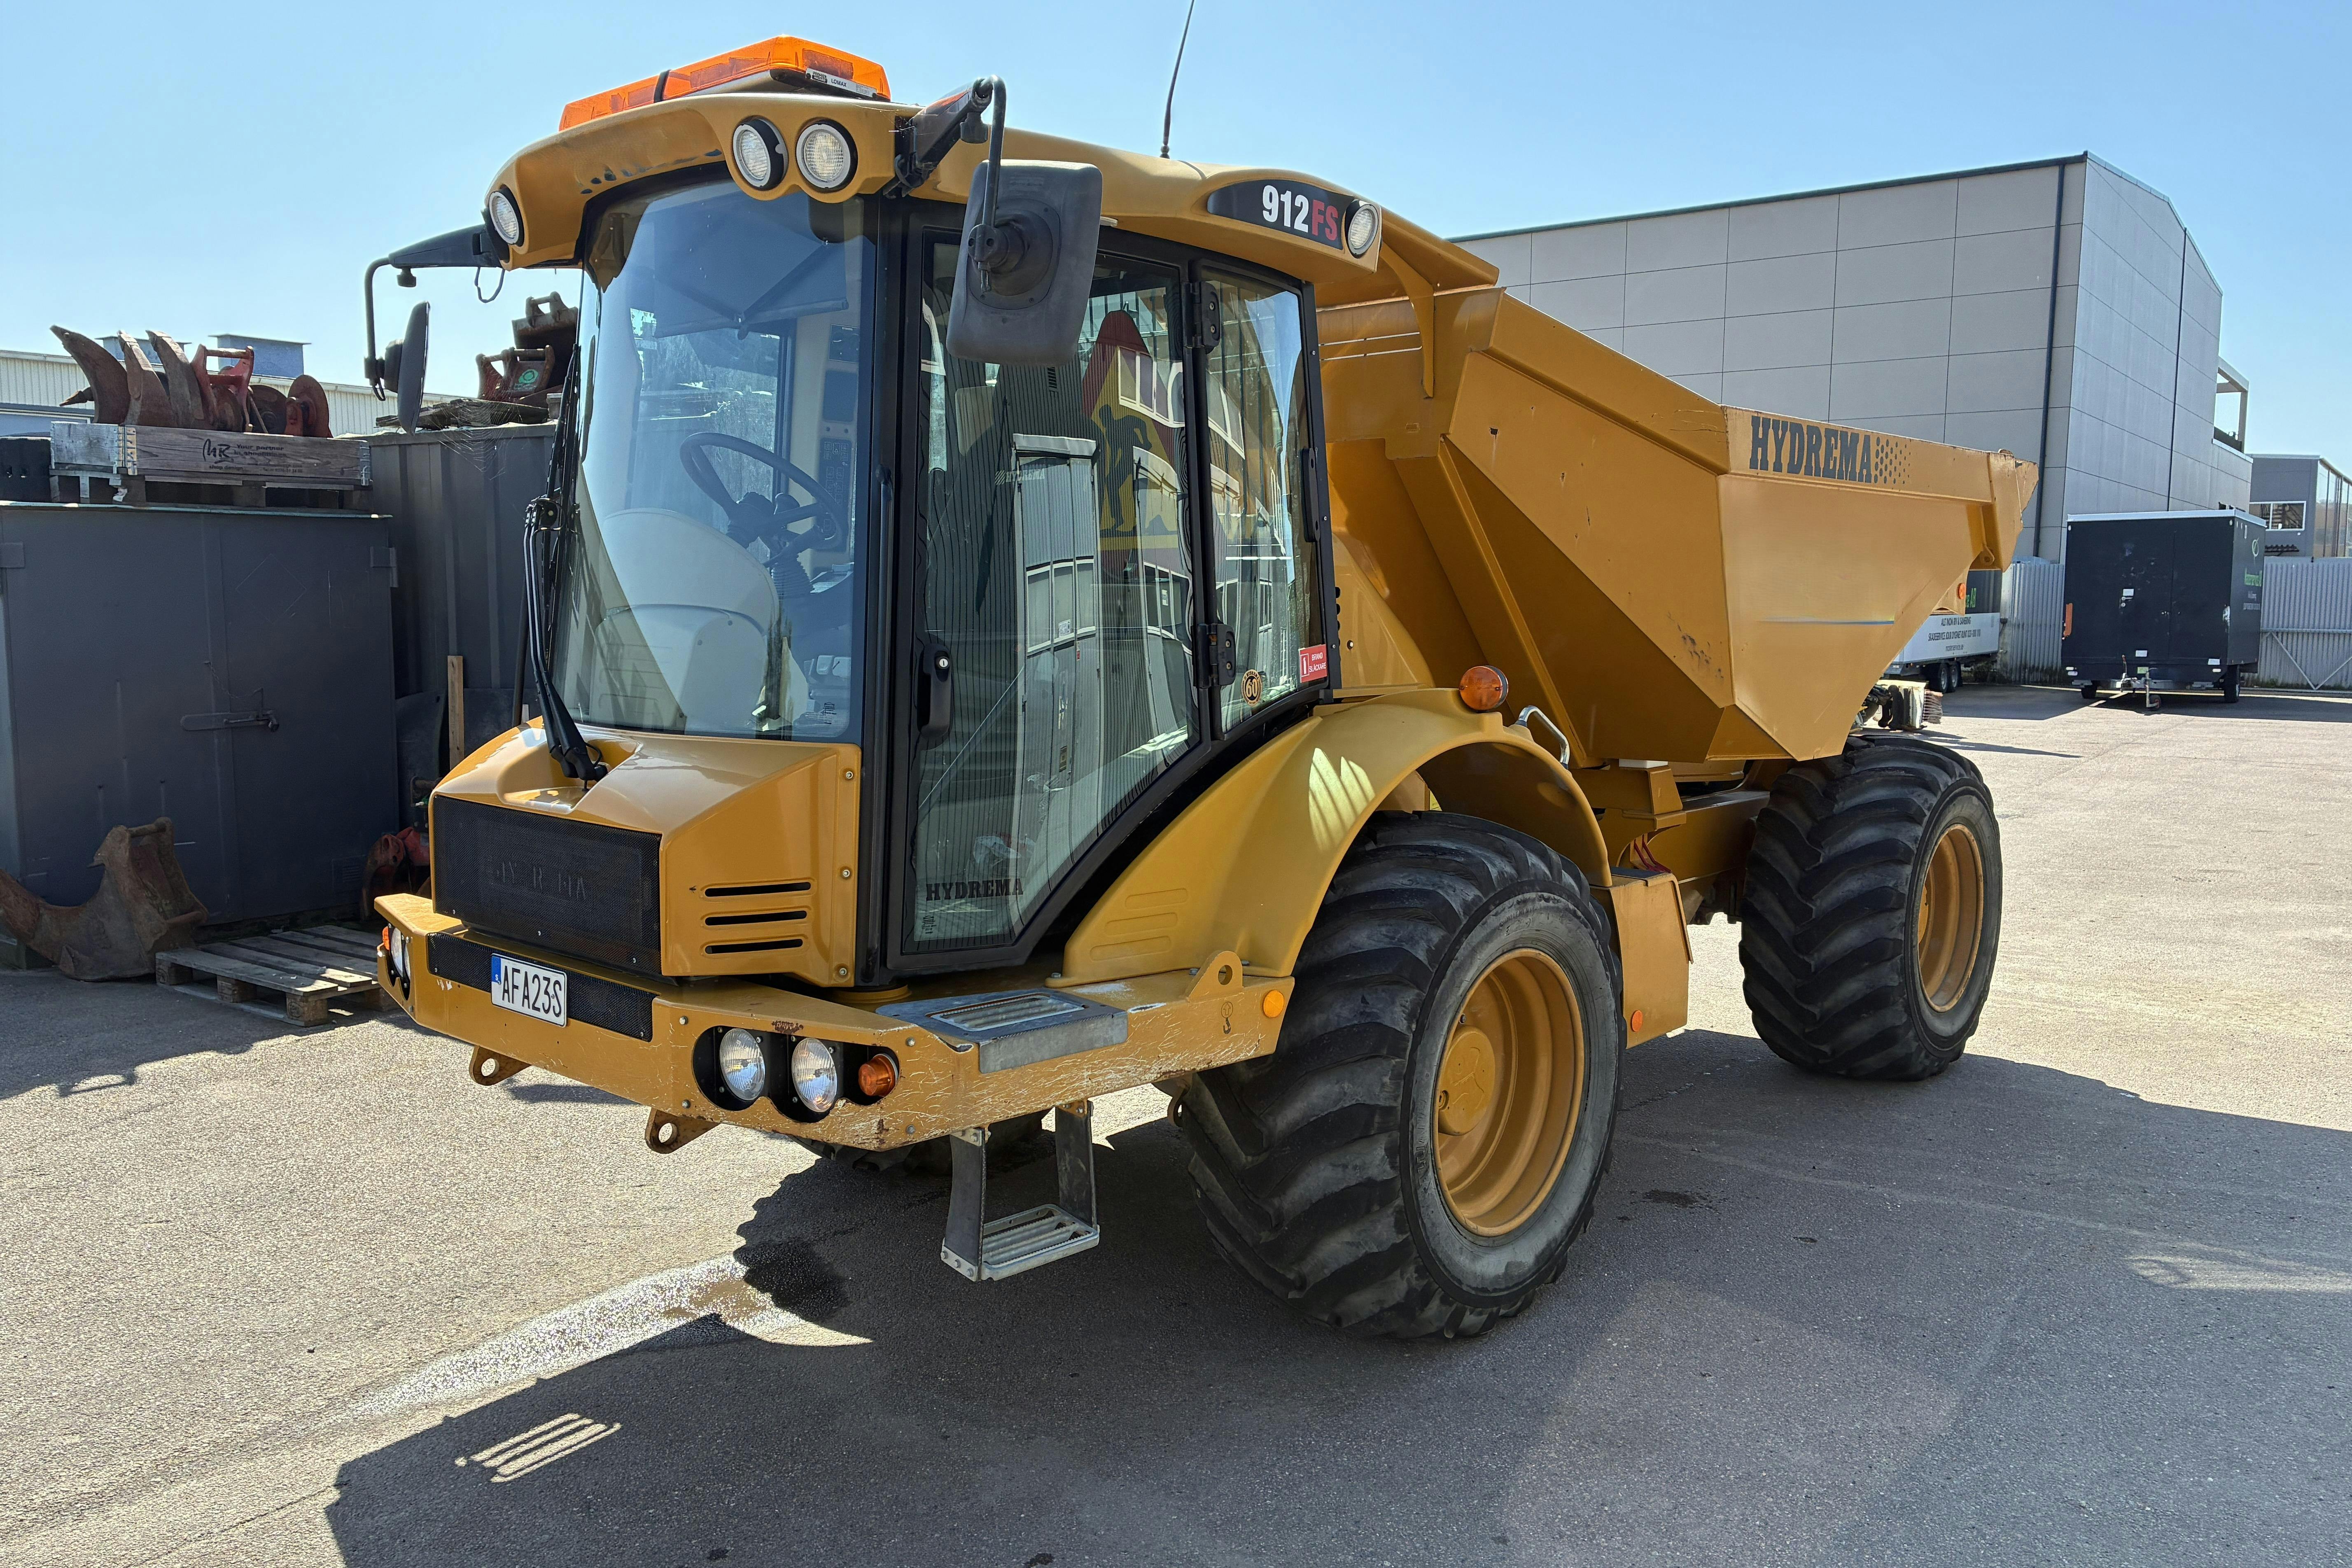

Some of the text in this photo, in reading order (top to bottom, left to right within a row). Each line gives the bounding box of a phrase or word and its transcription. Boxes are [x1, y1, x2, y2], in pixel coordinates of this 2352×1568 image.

[831, 78, 847, 87] LOMAX
[1749, 415, 1872, 483] HYDREMA
[1312, 652, 1323, 661] BRAND
[1246, 678, 1258, 698] 60
[926, 878, 1024, 901] HYDREMA
[502, 966, 562, 1017] AFA23S
